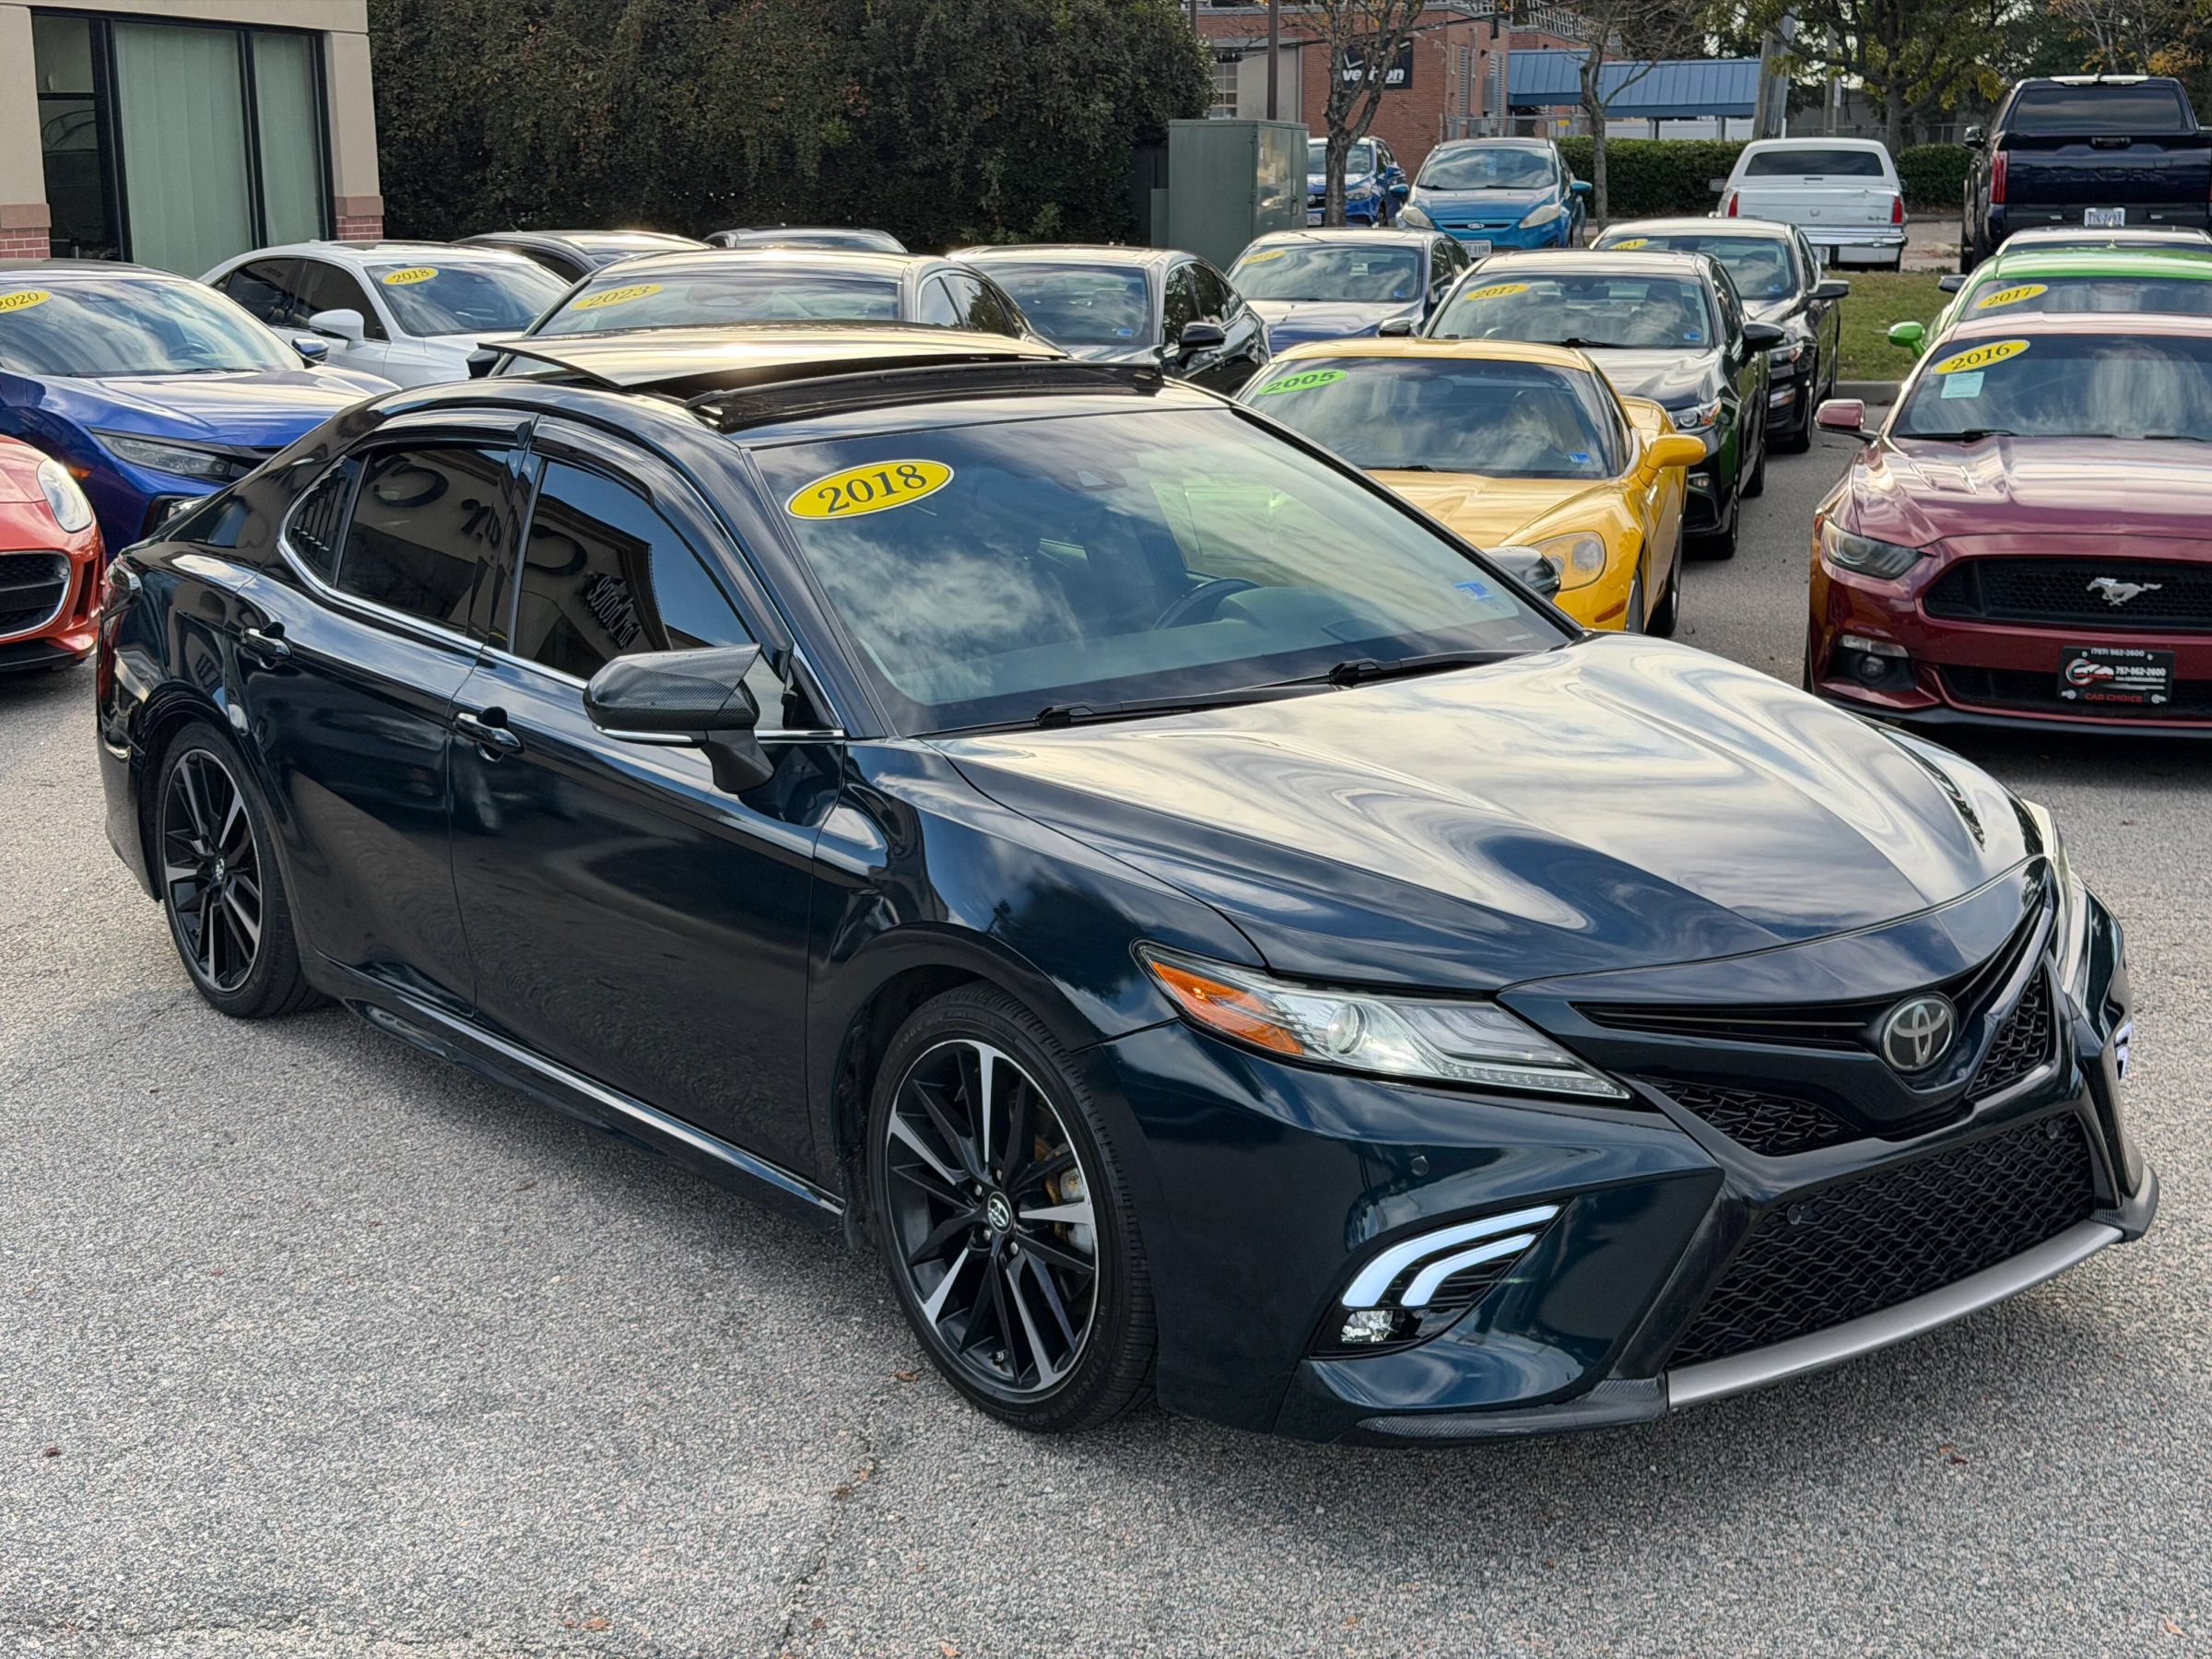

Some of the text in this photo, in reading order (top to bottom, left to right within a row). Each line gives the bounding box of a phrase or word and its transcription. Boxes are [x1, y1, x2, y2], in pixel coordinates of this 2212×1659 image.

[393, 268, 429, 283] 2018
[586, 286, 650, 307] 2023
[1475, 285, 1519, 299] 2017
[1987, 287, 2033, 306] 2017
[1950, 343, 2011, 371] 2016
[1264, 371, 1337, 393] 2005
[818, 465, 927, 513] 2018
[2106, 693, 2144, 702] CHOICE
